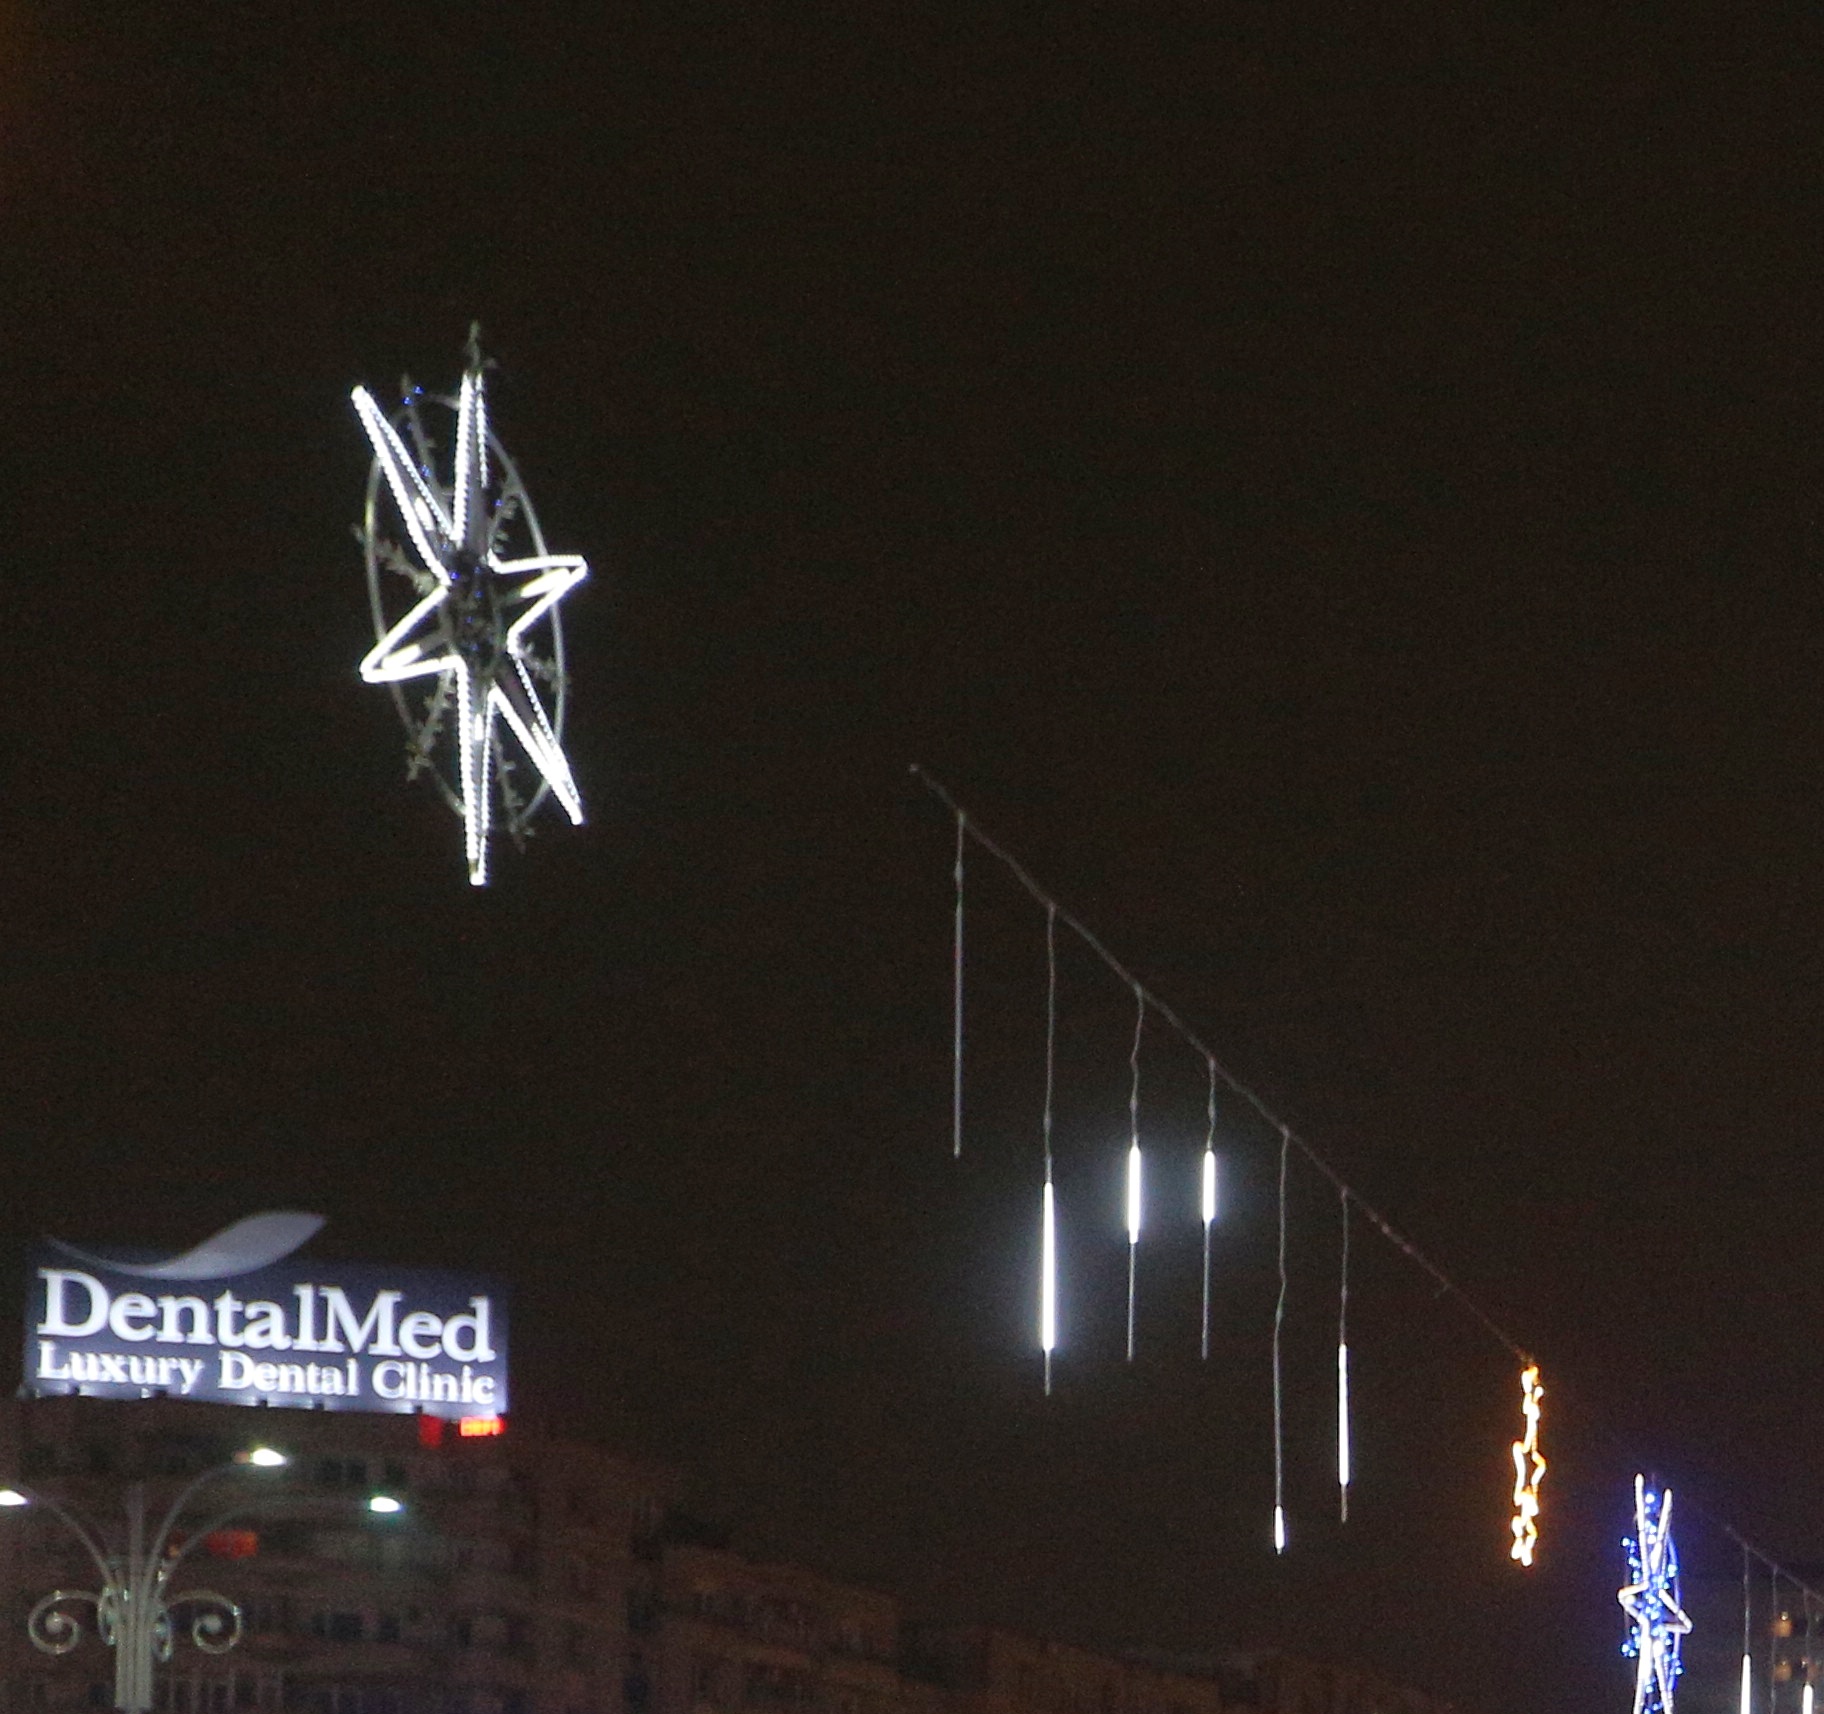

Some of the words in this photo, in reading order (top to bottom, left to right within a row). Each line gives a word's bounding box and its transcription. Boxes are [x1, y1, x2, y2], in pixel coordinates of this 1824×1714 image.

[36, 1267, 496, 1363] DentalMed
[36, 1341, 205, 1395] Luxury
[217, 1349, 360, 1397] Dental
[372, 1358, 497, 1405] Clinic
